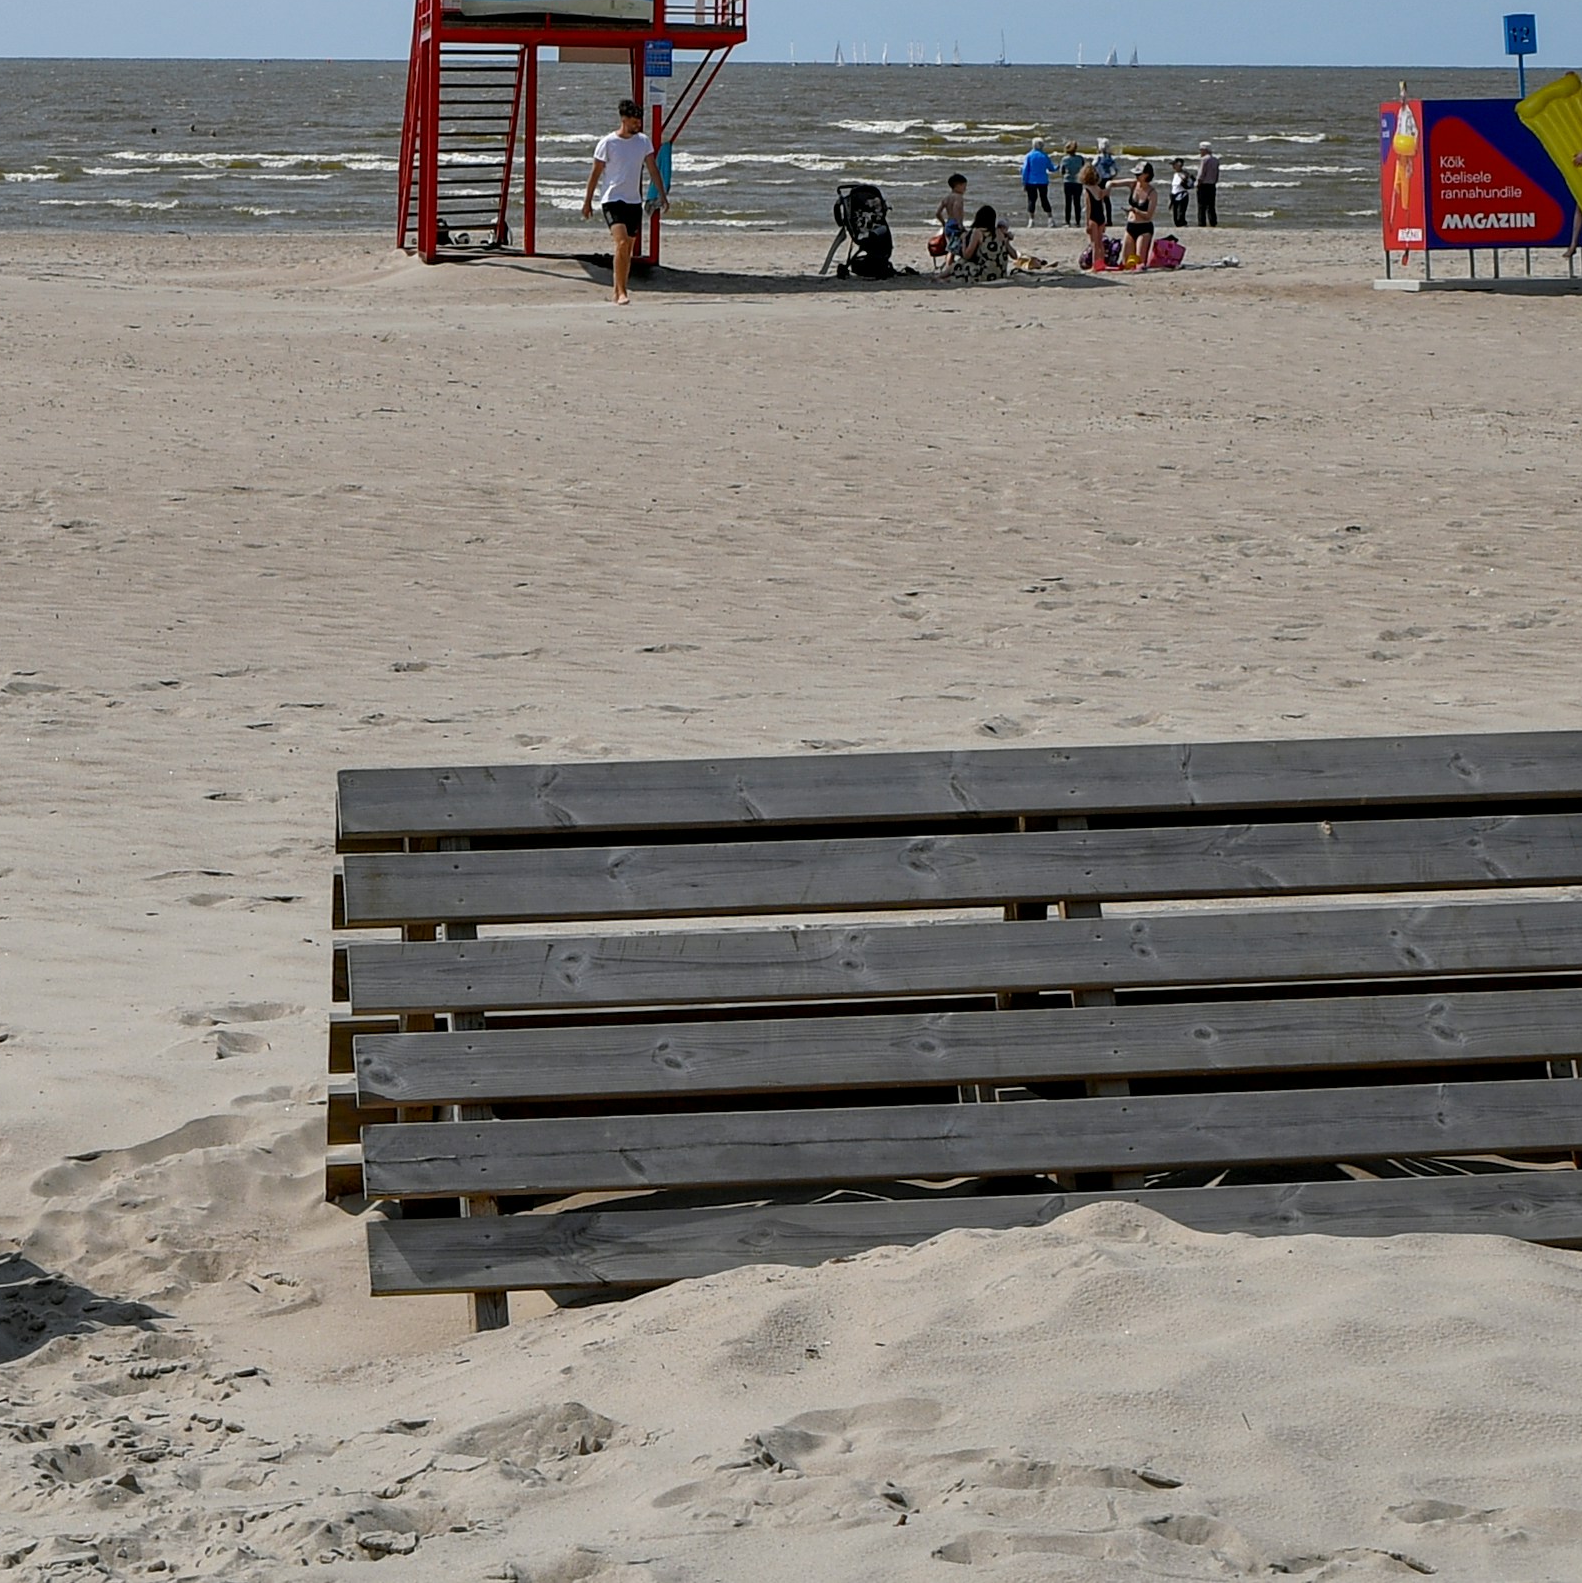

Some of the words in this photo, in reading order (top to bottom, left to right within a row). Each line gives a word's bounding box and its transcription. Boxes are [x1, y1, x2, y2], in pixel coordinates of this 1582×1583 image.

[1509, 26, 1530, 43] 12
[1439, 155, 1466, 169] Kõik
[1440, 170, 1492, 184] tõelisele
[1440, 185, 1523, 200] rannahundile
[1441, 212, 1536, 230] MAGAZIIN
